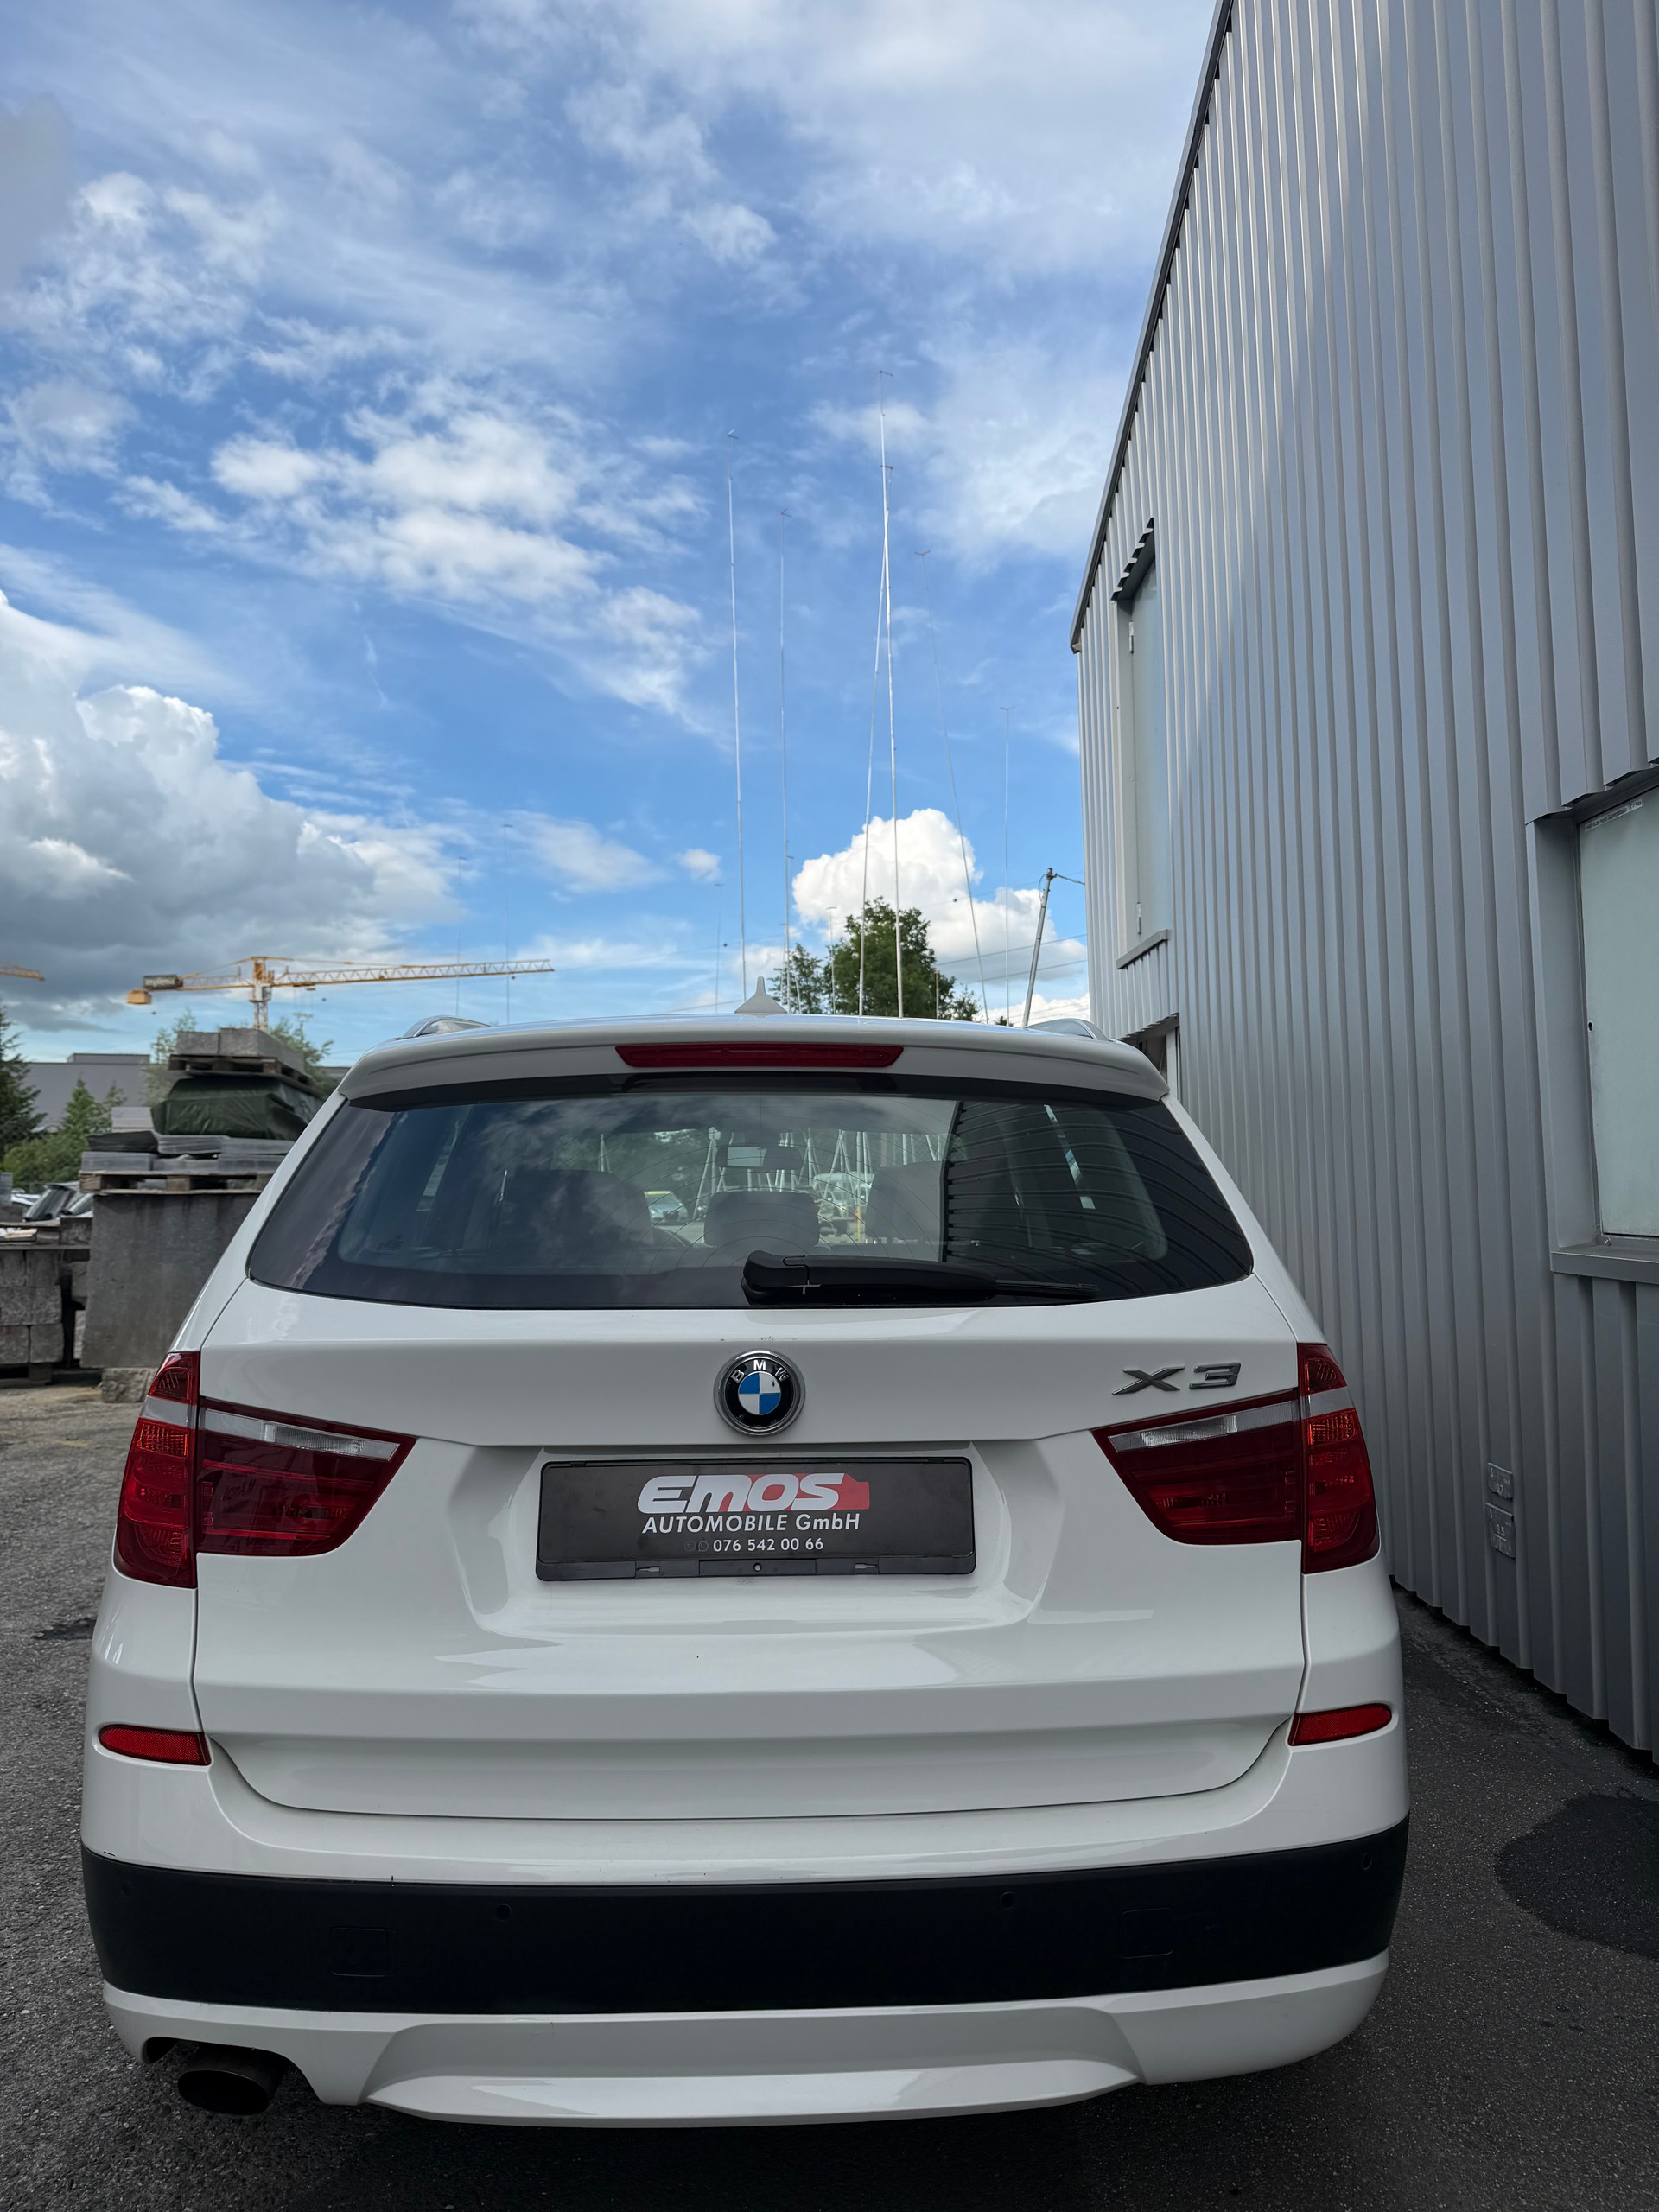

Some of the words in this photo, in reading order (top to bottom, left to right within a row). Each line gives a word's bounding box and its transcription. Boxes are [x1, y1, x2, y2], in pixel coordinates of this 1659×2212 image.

[731, 1359, 790, 1382] BMW
[1111, 1363, 1242, 1395] X3
[642, 1514, 788, 1534] AUTOMOBILE
[795, 1513, 860, 1531] GmbH
[713, 1539, 741, 1552] 076
[747, 1538, 775, 1551] 542
[780, 1537, 800, 1550] 00
[805, 1537, 823, 1550] 66
